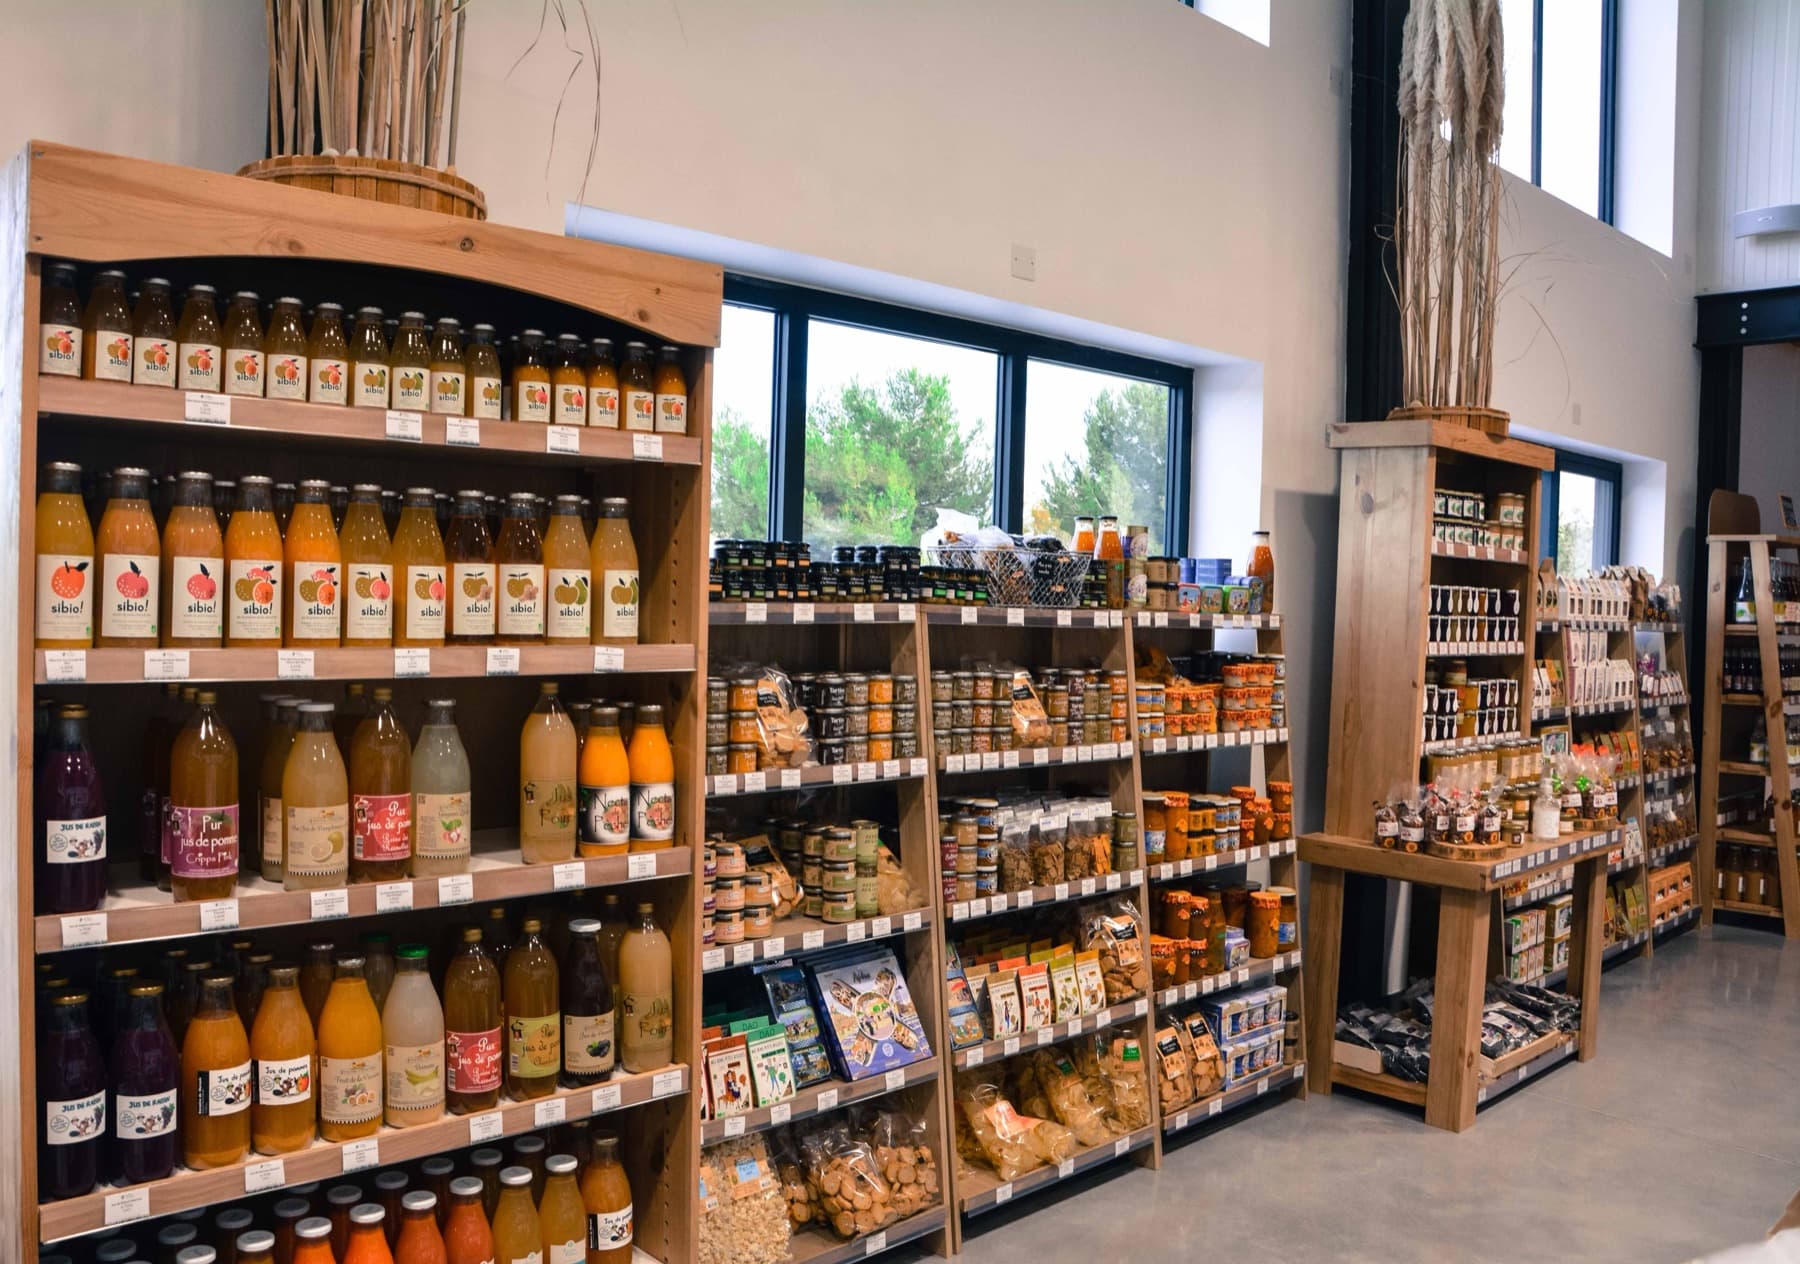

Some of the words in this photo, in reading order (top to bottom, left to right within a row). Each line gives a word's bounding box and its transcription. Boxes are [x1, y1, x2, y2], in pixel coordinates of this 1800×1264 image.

[109, 357, 129, 367] sibio
[146, 363, 170, 372] sibio!
[190, 367, 213, 376] sibio!
[237, 373, 259, 382] sibio!
[277, 377, 300, 386] sibio!
[321, 382, 342, 391] sibio!
[51, 600, 84, 615] sibio!
[117, 600, 149, 613] sibio!
[187, 600, 216, 614] sibio!
[243, 602, 273, 615] sibio!
[308, 602, 335, 616] sibio!
[361, 605, 387, 616] sibio!
[420, 606, 444, 616] sibio!
[467, 602, 491, 613] sibio!
[510, 602, 536, 613] sibio!
[560, 606, 585, 617] sibio!
[388, 801, 406, 817] Pur
[60, 823, 74, 831] JUS
[202, 815, 222, 833] Pur
[366, 819, 382, 836] jus
[385, 817, 395, 830] de
[179, 834, 194, 854] jus
[195, 831, 209, 847] de
[760, 1028, 775, 1039] DAO
[478, 1037, 495, 1052] Pur
[458, 1055, 471, 1070] jus
[475, 1053, 483, 1064] de
[265, 1066, 276, 1074] Jus
[218, 1076, 229, 1084] Jus
[62, 1104, 75, 1113] JUS
[128, 1101, 140, 1109] JUS
